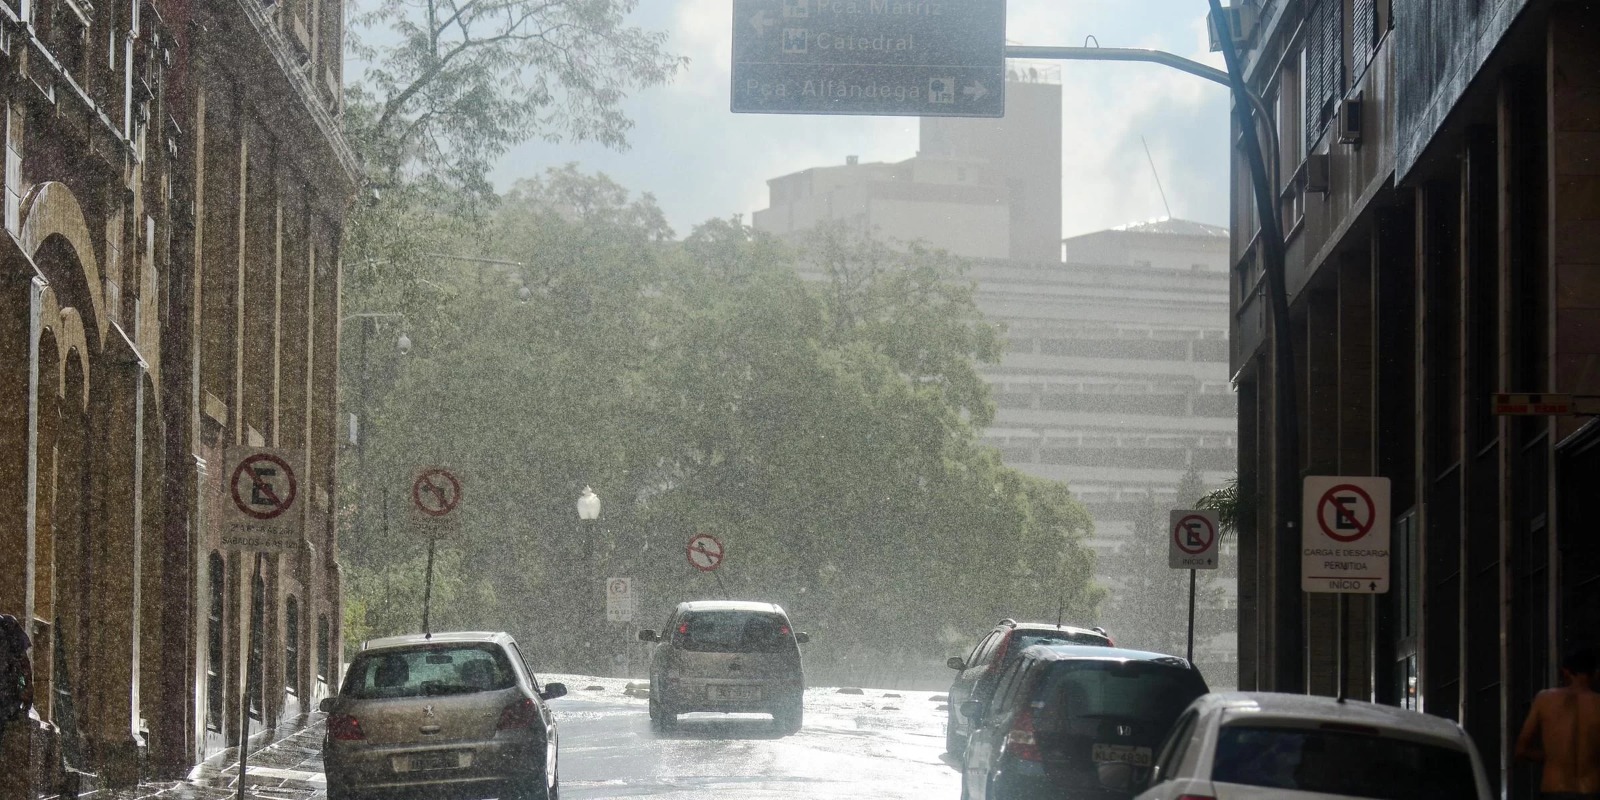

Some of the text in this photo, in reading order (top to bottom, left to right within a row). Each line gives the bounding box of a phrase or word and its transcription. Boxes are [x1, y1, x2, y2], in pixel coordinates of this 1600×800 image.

[870, 0, 940, 15] Matriz
[816, 32, 914, 51] Catedral
[1303, 548, 1389, 557] CARGA E DESCARGA
[1324, 561, 1368, 570] PERMITIDA
